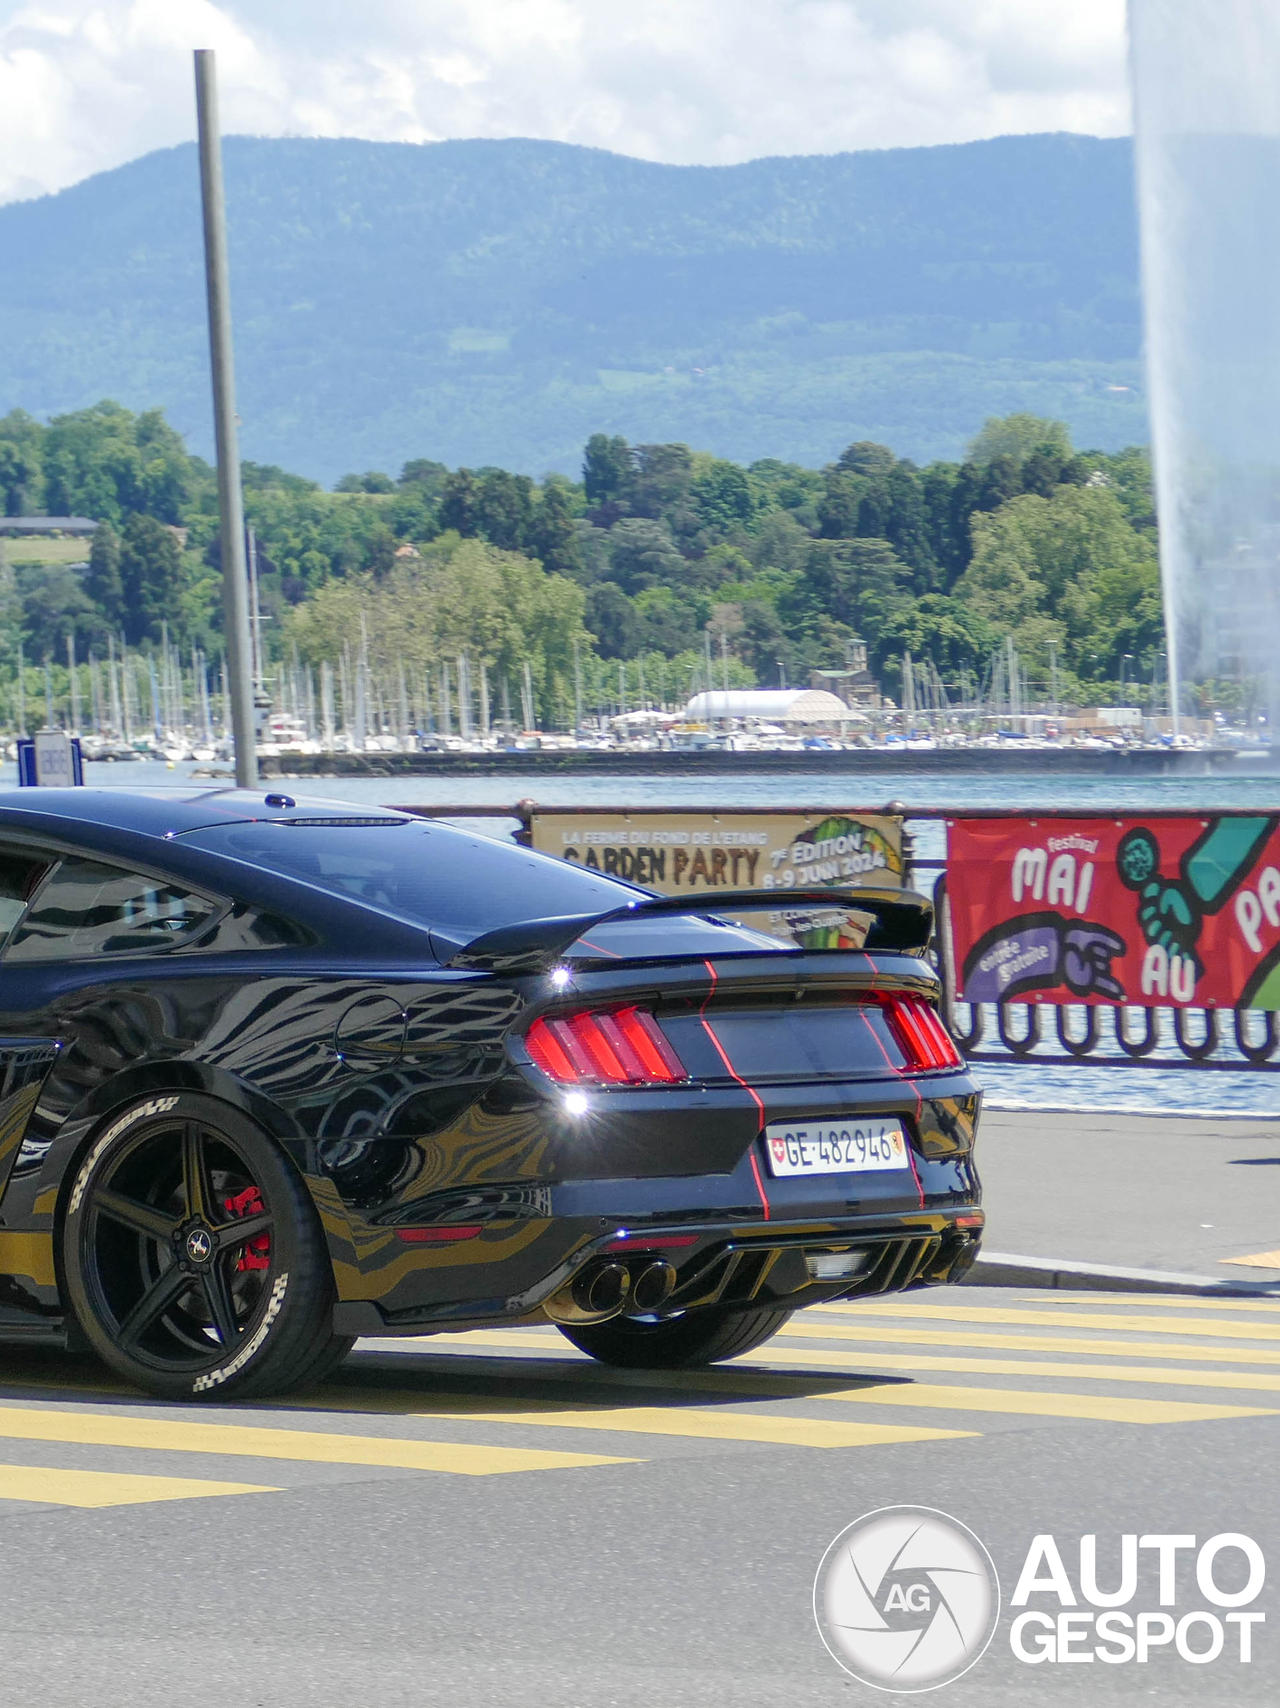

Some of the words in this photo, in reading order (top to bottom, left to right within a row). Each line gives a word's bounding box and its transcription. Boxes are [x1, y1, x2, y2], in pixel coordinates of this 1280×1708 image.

[562, 832, 582, 844] LA
[584, 832, 628, 844] FERME
[630, 832, 651, 844] DU
[652, 832, 690, 844] FOND
[692, 832, 712, 844] DE
[791, 833, 862, 865] EDITION
[673, 848, 762, 886] PARTY
[762, 869, 796, 889] 8-9
[798, 861, 840, 885] JUIN
[841, 851, 886, 876] 2024
[1012, 848, 1094, 914] MAI
[1141, 944, 1195, 1002] AU
